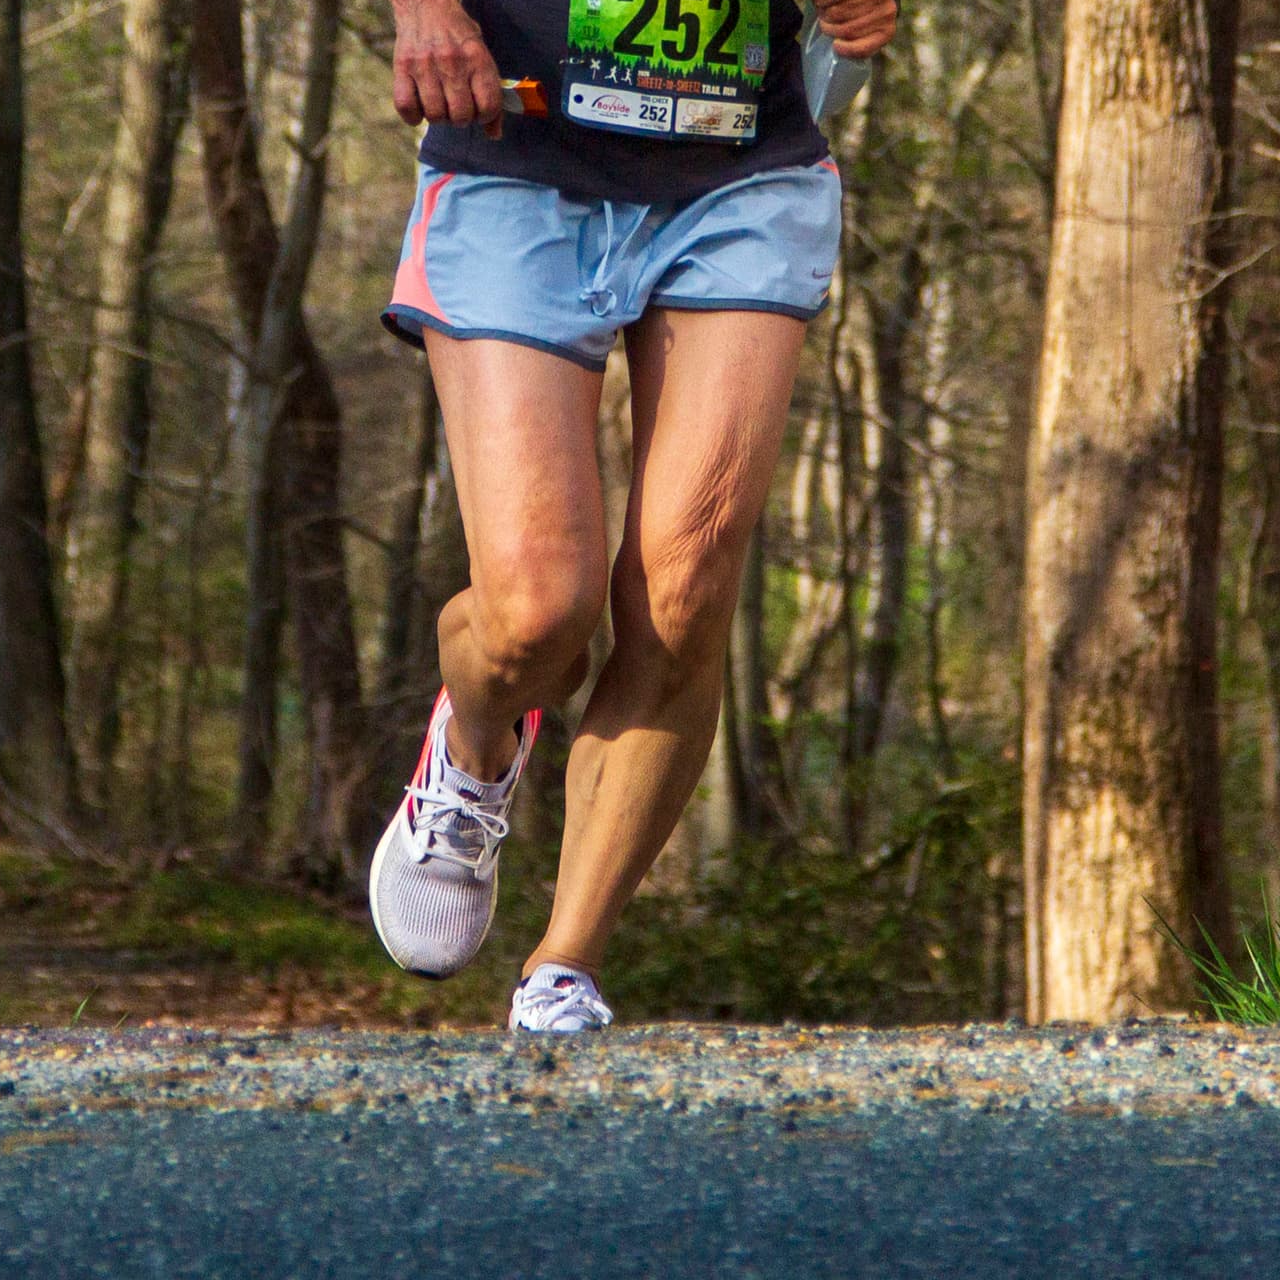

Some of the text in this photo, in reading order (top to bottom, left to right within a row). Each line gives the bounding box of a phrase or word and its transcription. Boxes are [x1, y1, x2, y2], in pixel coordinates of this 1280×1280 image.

[597, 100, 630, 114] Bayside
[639, 104, 668, 123] 252
[733, 113, 754, 129] 252
